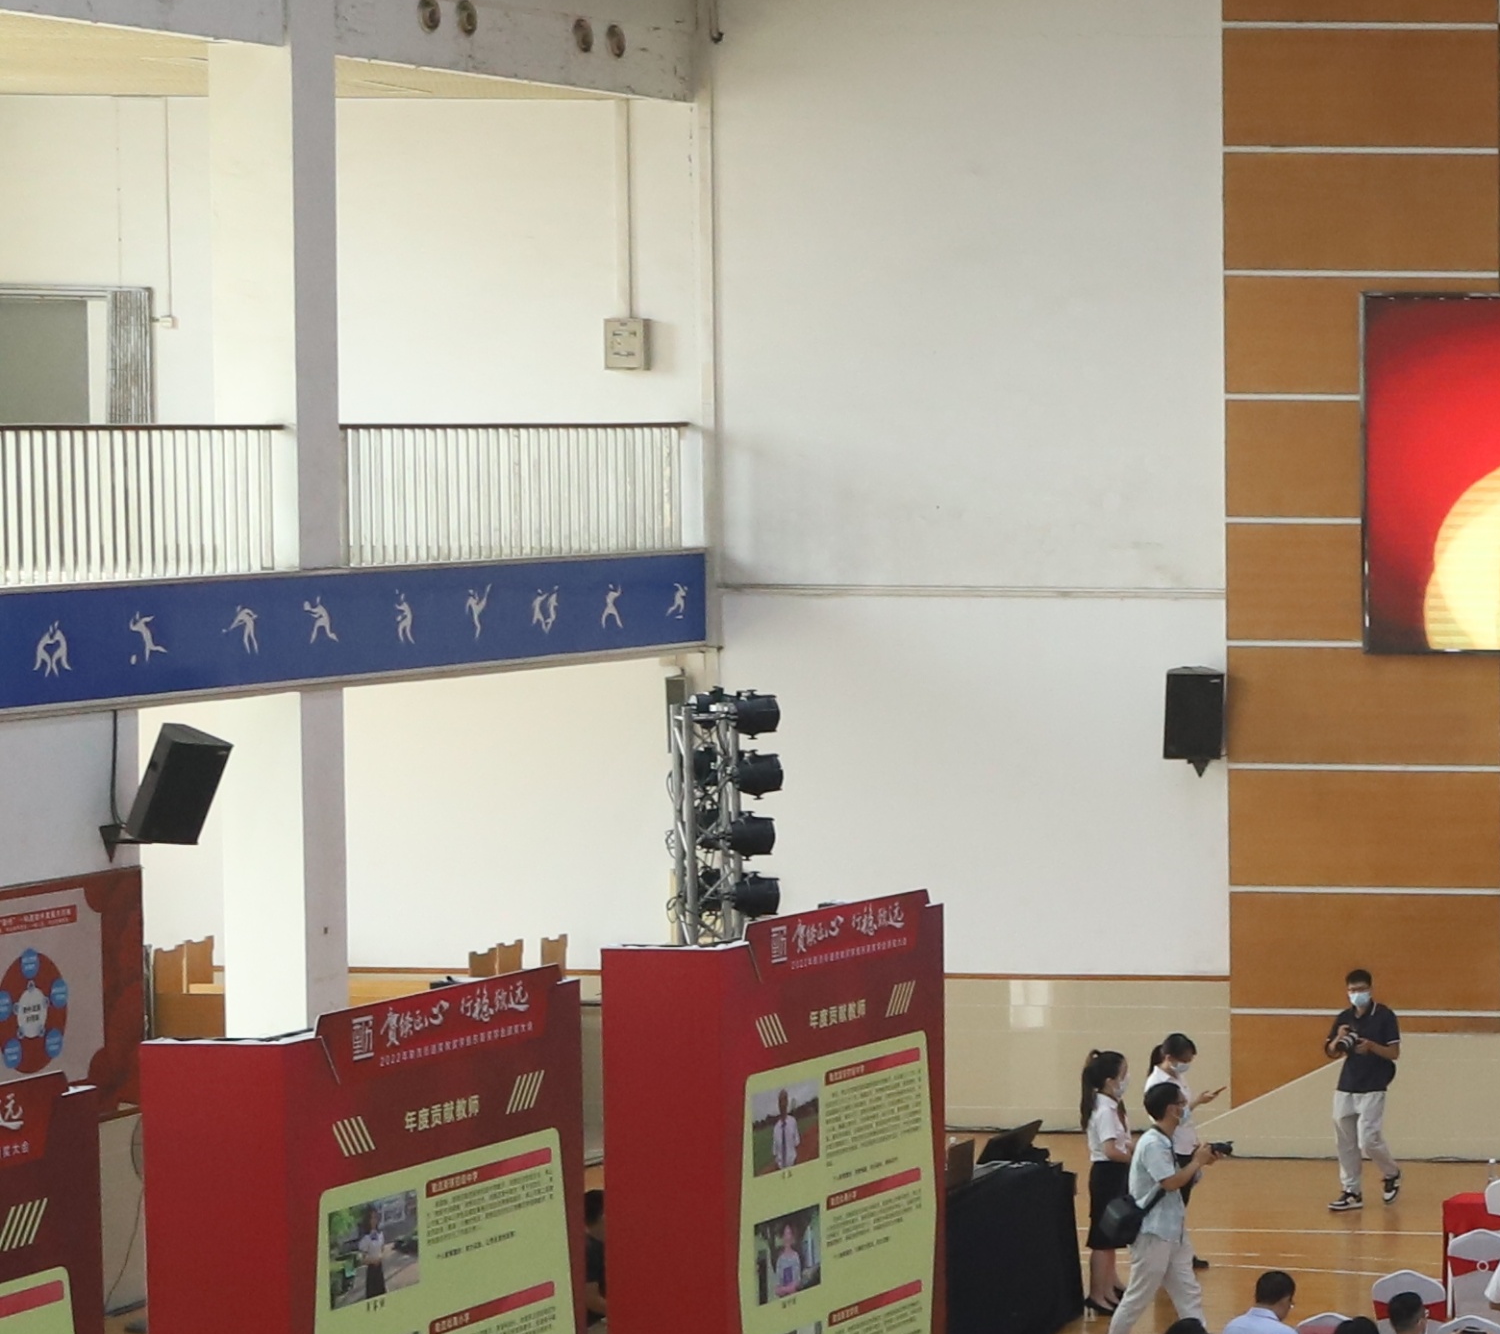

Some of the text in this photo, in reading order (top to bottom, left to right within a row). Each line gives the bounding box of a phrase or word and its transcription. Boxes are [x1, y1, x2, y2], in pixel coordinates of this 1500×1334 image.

[809, 999, 866, 1029] 年度贡献教师
[404, 1095, 480, 1132] 年度贡献教师
